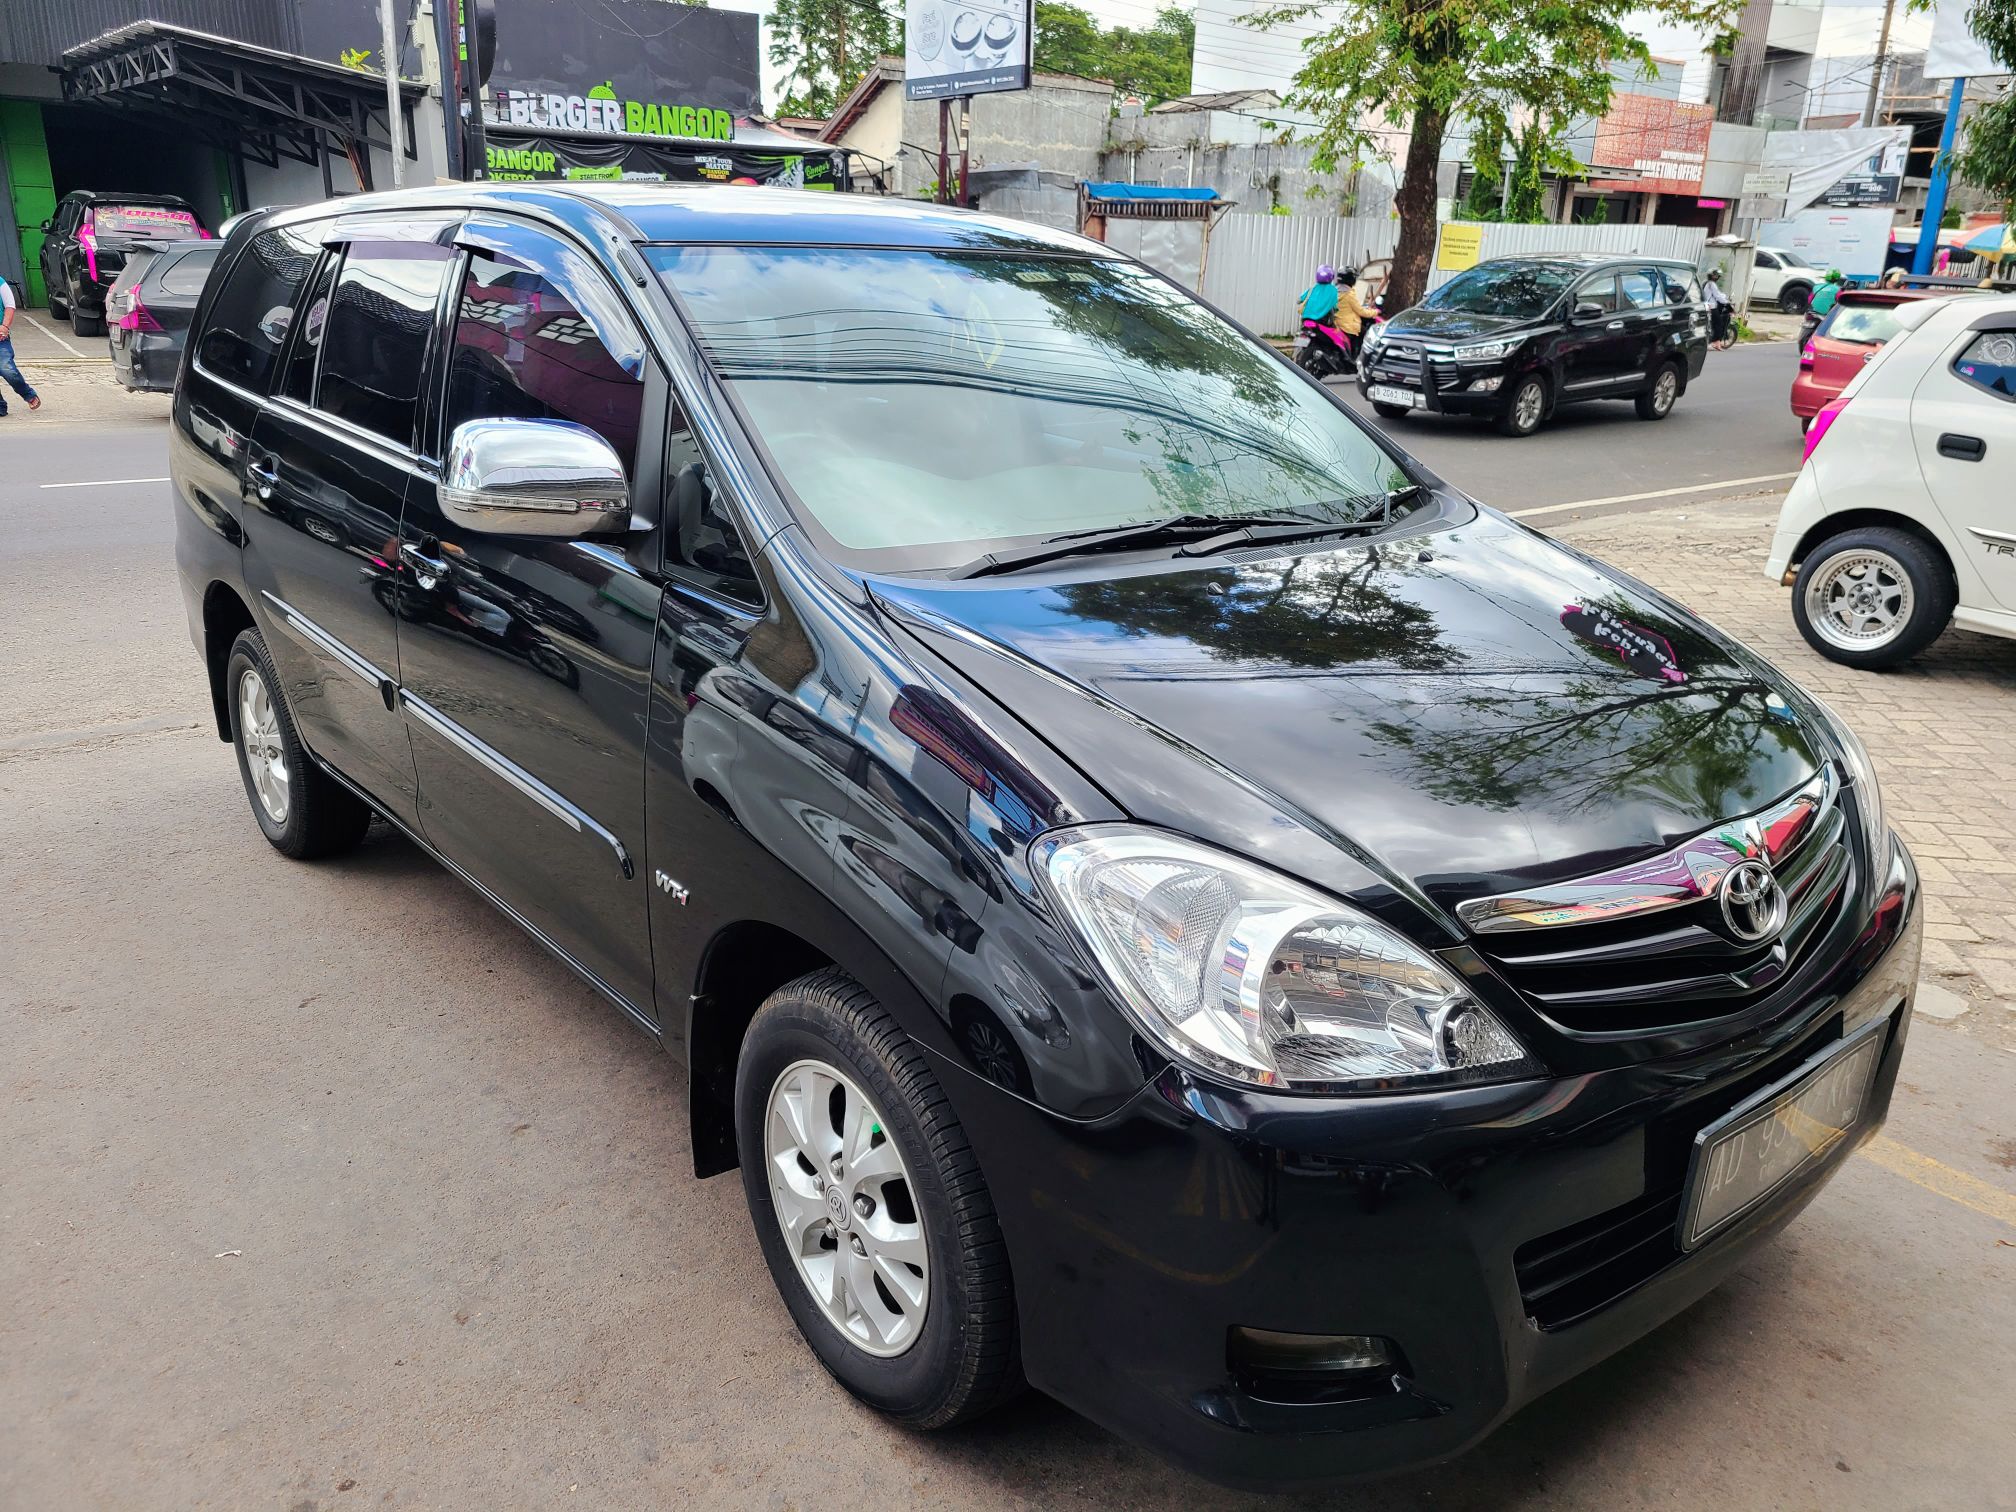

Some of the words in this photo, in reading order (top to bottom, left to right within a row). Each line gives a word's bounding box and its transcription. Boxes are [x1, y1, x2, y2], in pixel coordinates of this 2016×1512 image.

[509, 90, 620, 132] BURGER
[626, 101, 731, 142] BANGOR
[1634, 160, 1678, 179] MARKETING
[1677, 163, 1703, 181] OFFICE
[1709, 1131, 1746, 1197] AD
